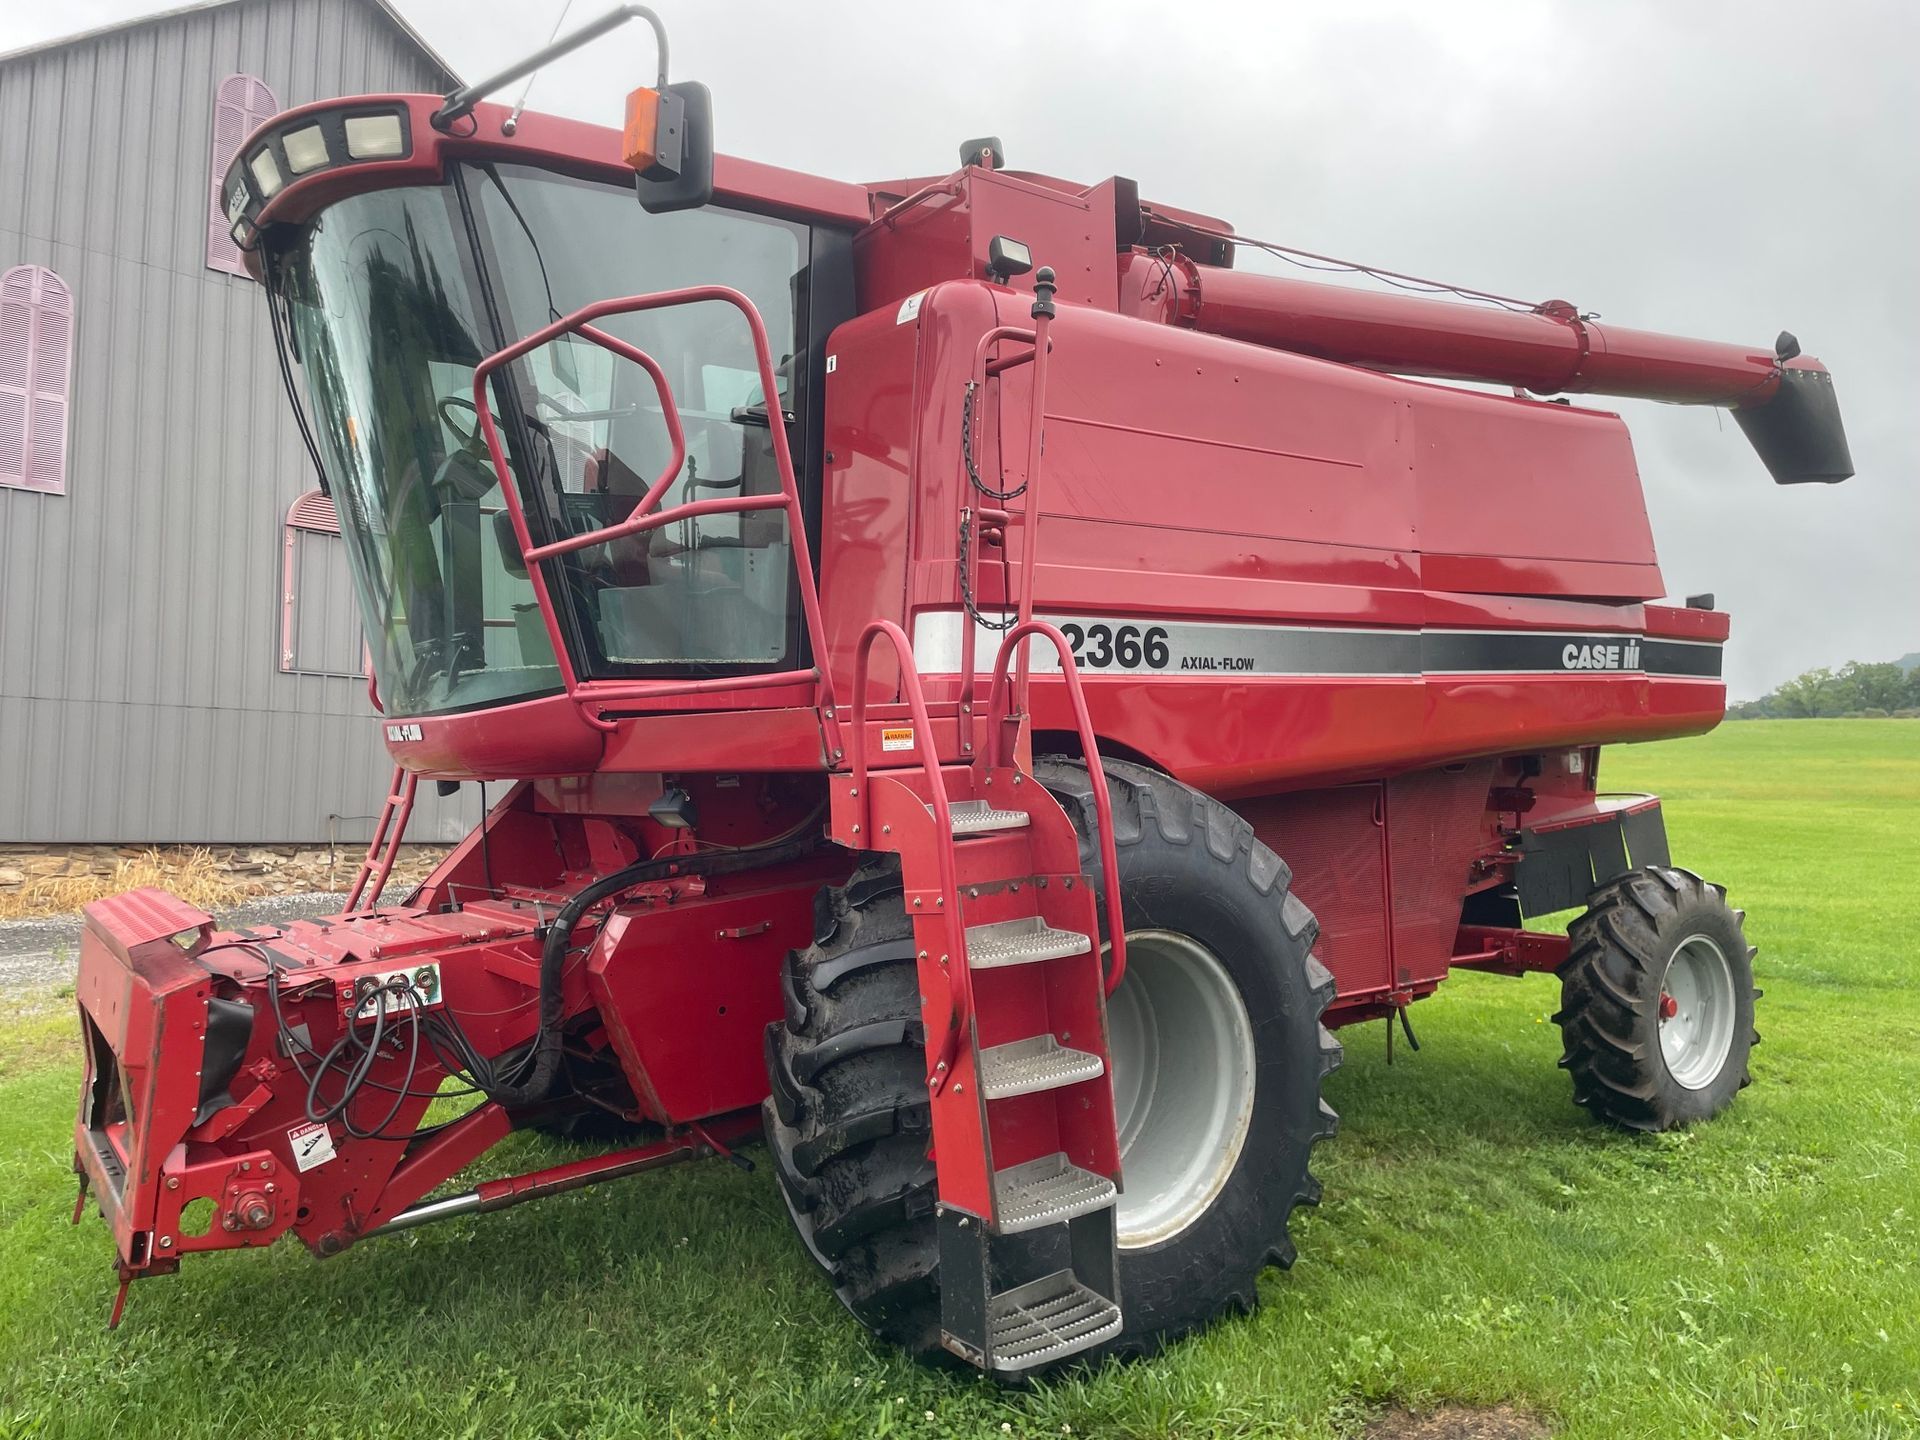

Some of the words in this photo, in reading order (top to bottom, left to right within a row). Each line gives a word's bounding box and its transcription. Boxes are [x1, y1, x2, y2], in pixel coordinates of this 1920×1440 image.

[1058, 623, 1169, 669] 2366
[1180, 656, 1255, 671] AXIAL-FLOW
[1562, 643, 1619, 669] CASE
